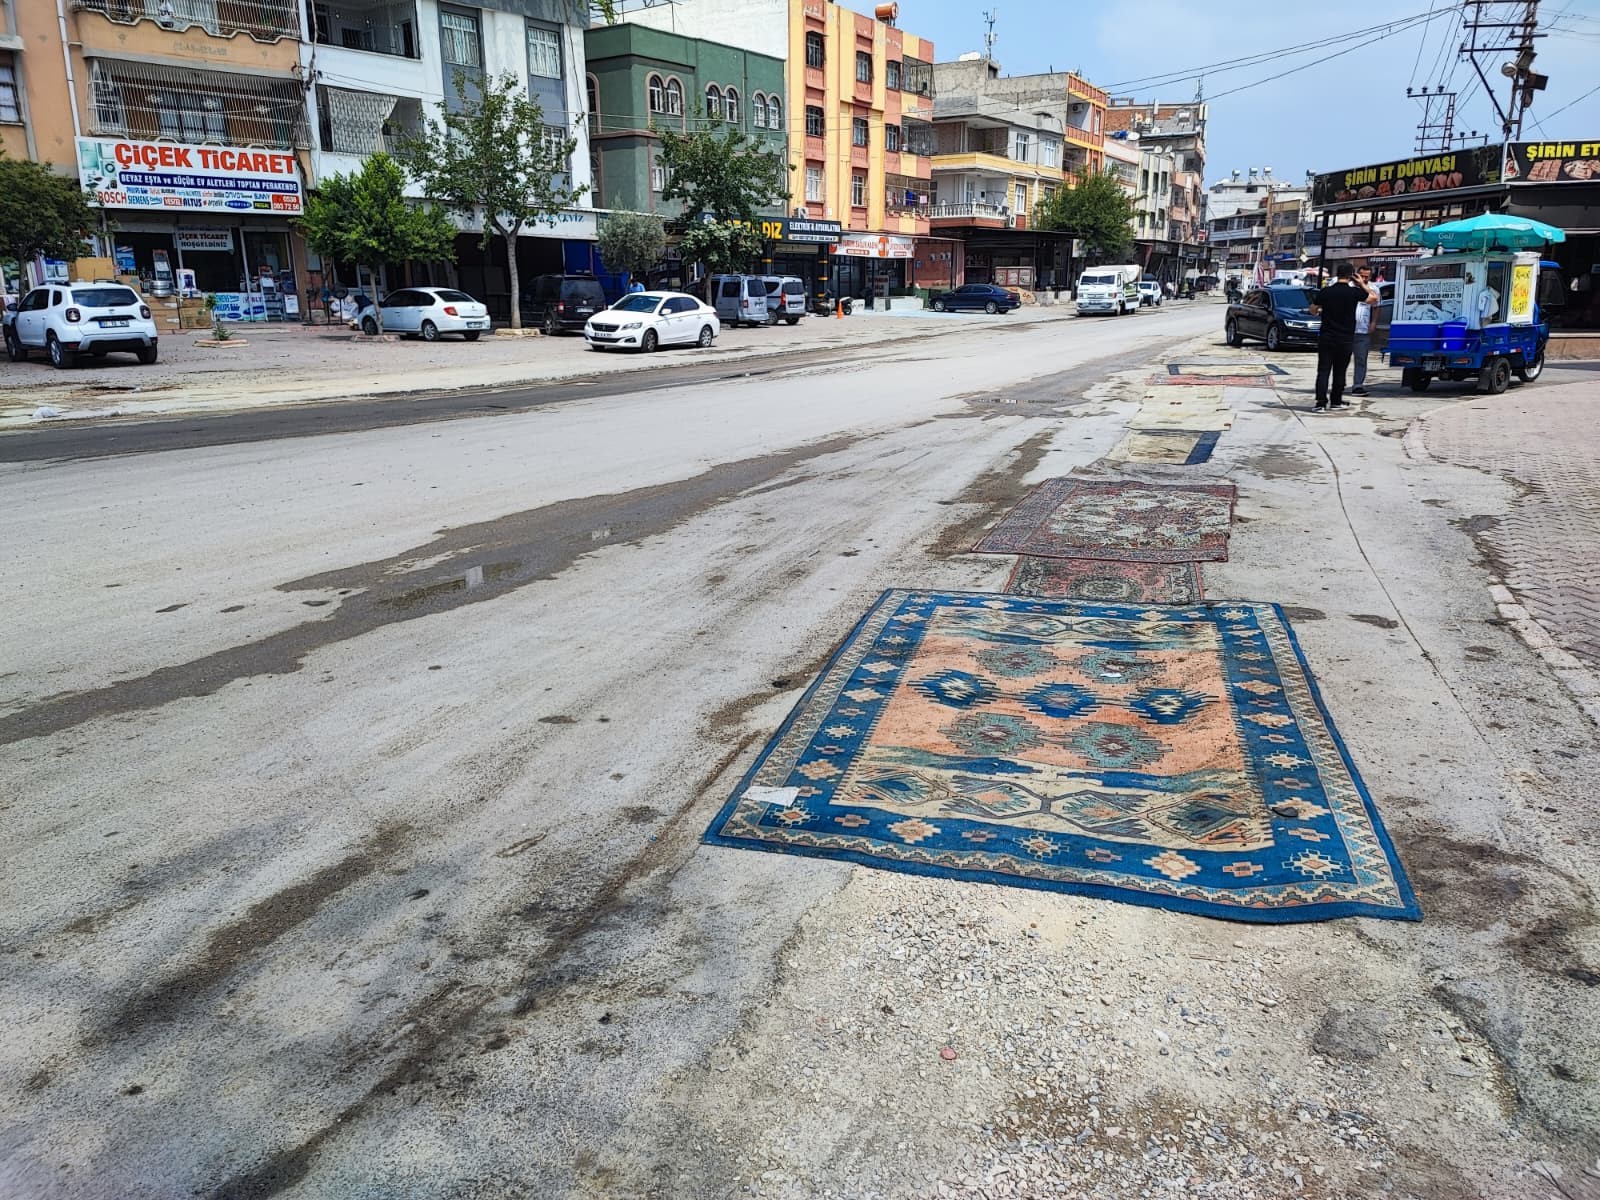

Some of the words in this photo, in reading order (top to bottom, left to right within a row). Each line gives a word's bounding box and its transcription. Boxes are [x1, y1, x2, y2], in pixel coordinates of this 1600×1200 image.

[1526, 142, 1576, 161] ŞİRİN
[1580, 143, 1600, 157] ET
[1345, 167, 1377, 189] ŞİRİN
[1380, 165, 1393, 181] ET
[1397, 155, 1456, 177] DÜNYASI
[121, 173, 143, 183] BEYAZ
[145, 175, 162, 186] EŞYA
[173, 176, 195, 187] KÜÇÜK
[206, 179, 236, 189] ALETLERİ
[238, 181, 261, 190] TOPTAN
[262, 182, 298, 192] PERAKENDE
[97, 191, 127, 205] BOSCH
[128, 196, 149, 206] SIEMENS
[183, 199, 202, 208] ALTUS
[181, 240, 228, 248] HOŞGELDİNİZ
